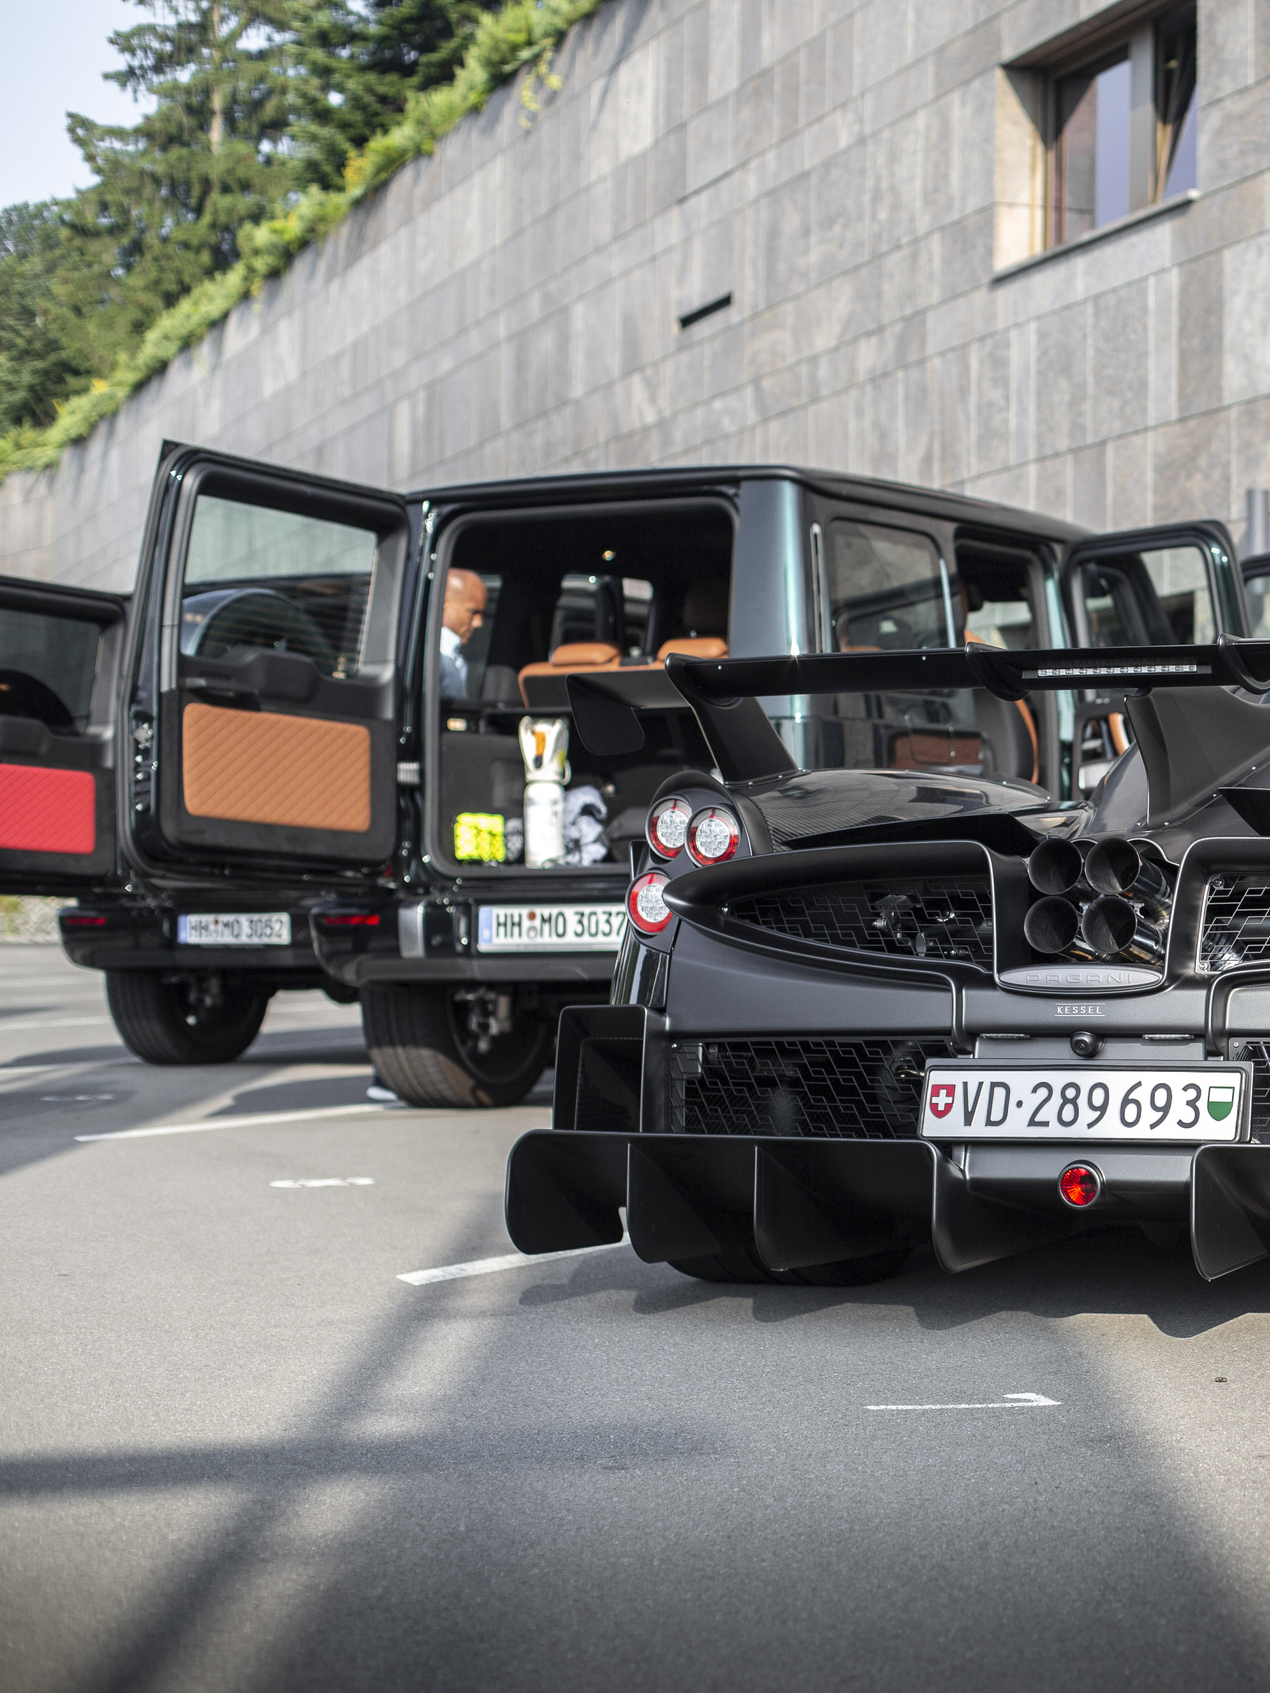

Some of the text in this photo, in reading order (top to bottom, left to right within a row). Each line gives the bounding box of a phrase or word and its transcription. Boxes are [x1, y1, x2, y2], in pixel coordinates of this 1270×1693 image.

[496, 911, 627, 938] HH MO 3037
[1026, 973, 1132, 984] PAGANI
[1056, 1005, 1102, 1015] KESSEL
